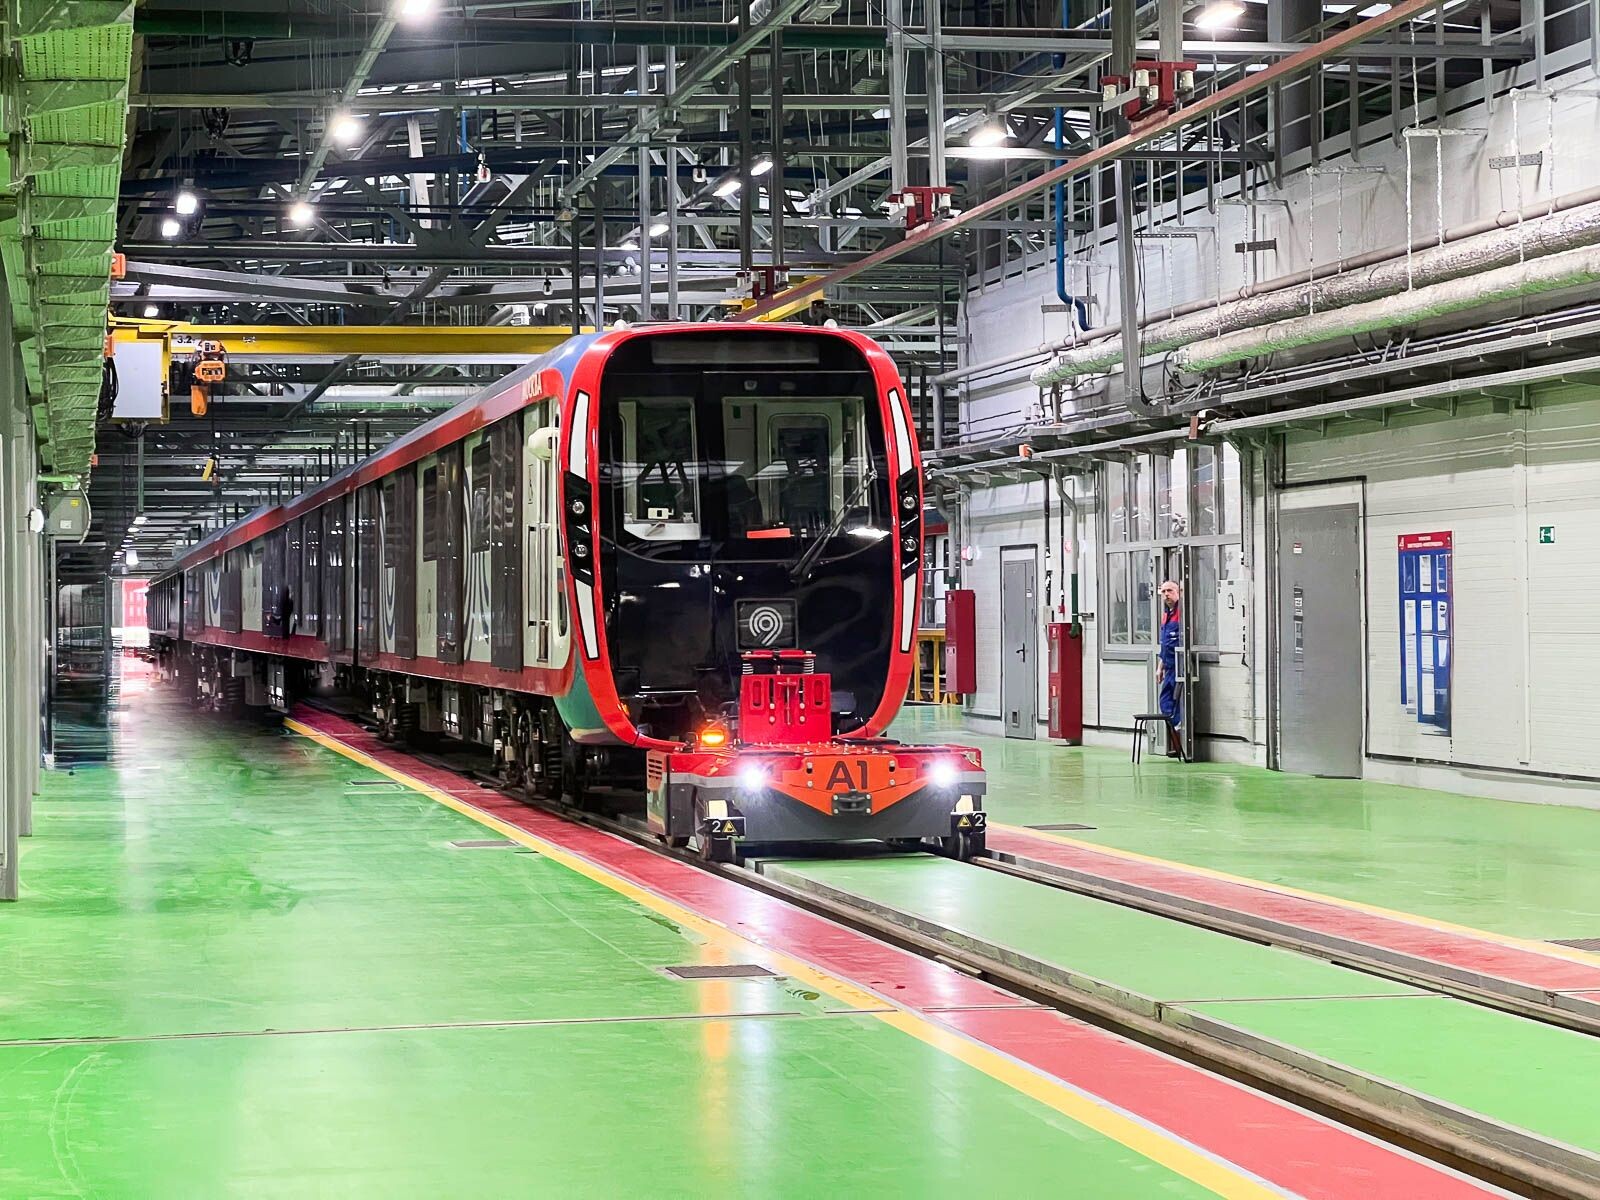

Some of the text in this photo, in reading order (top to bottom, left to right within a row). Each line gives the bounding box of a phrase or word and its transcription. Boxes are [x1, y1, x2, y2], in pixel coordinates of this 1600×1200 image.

[826, 760, 867, 790] A1
[711, 820, 721, 833] 2
[974, 814, 984, 827] 2
